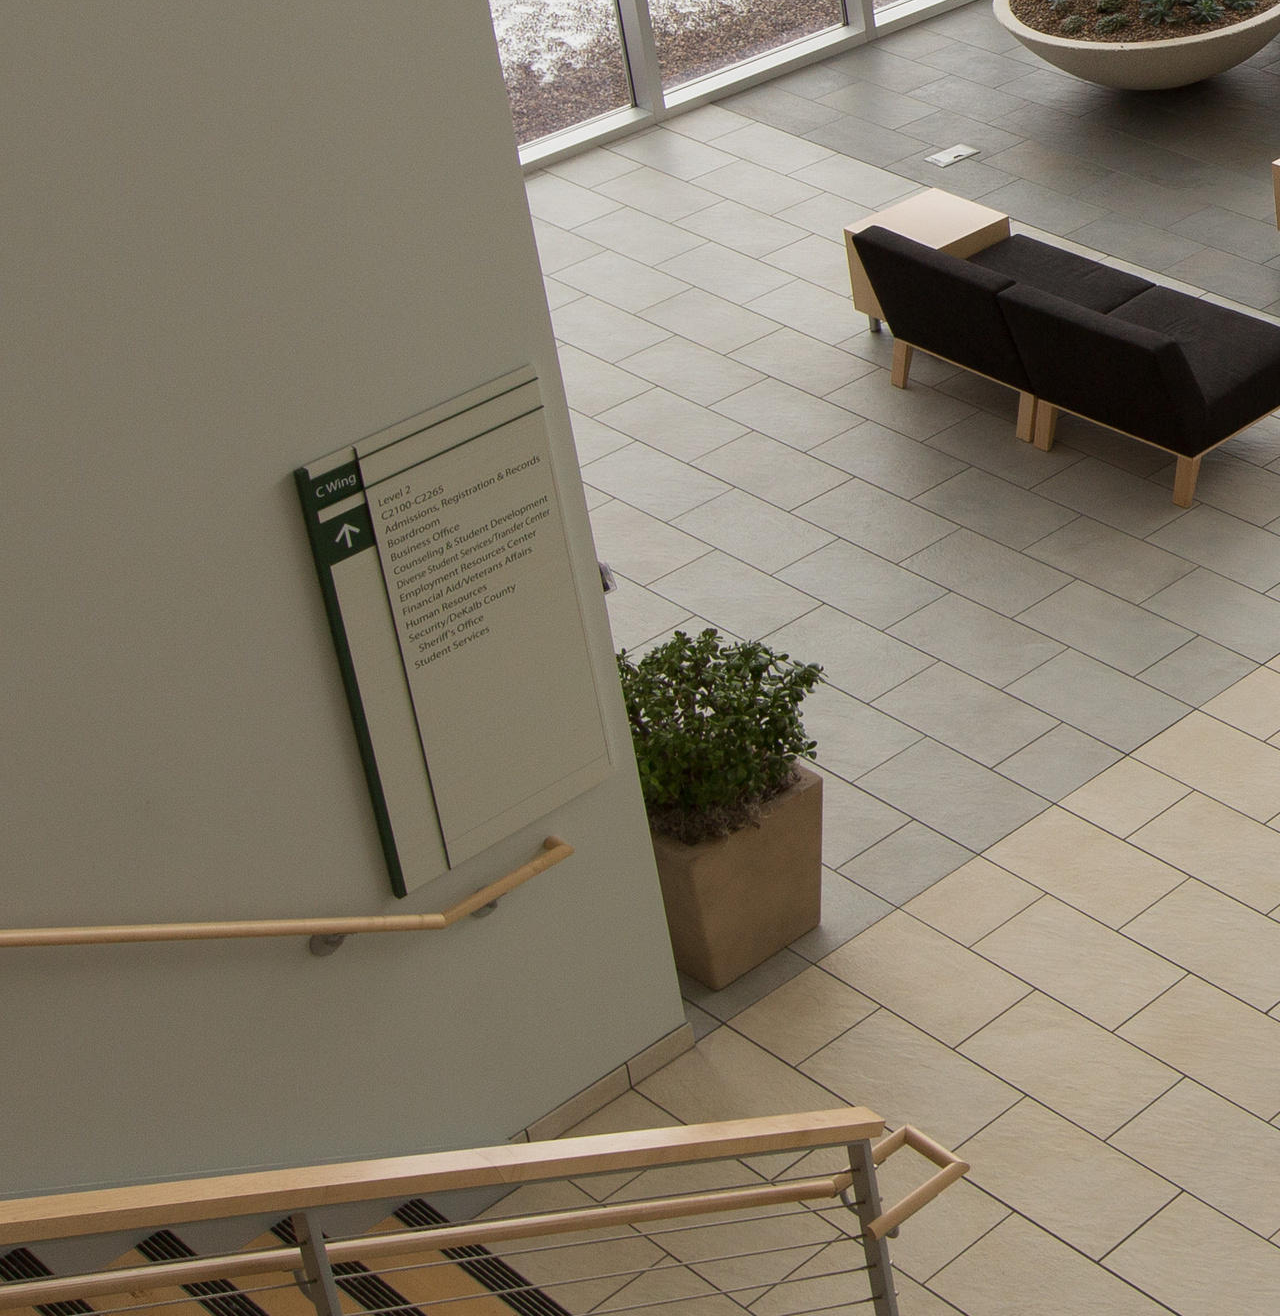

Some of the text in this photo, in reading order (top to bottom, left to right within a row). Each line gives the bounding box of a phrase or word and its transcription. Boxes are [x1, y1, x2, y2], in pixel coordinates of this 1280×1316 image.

[315, 474, 357, 498] C Wing
[378, 485, 411, 507] Level 2
[381, 485, 445, 520] C2100-C2265
[385, 455, 541, 534] Admissions, Registration & Records
[387, 518, 441, 549] Boardroom
[390, 523, 461, 562] Business Office
[393, 495, 549, 576] Counseling & Student Development
[396, 508, 551, 590] Diverse Student Services/Transfer Center
[399, 529, 537, 603] Employment Resources Center
[402, 547, 533, 616] Financial Aid/Veterans Affairs
[405, 584, 488, 630] Human Resources
[408, 584, 516, 643] Security/DeKalb County
[414, 626, 490, 670] Student Services
[418, 614, 485, 653] Sheriff's Office
